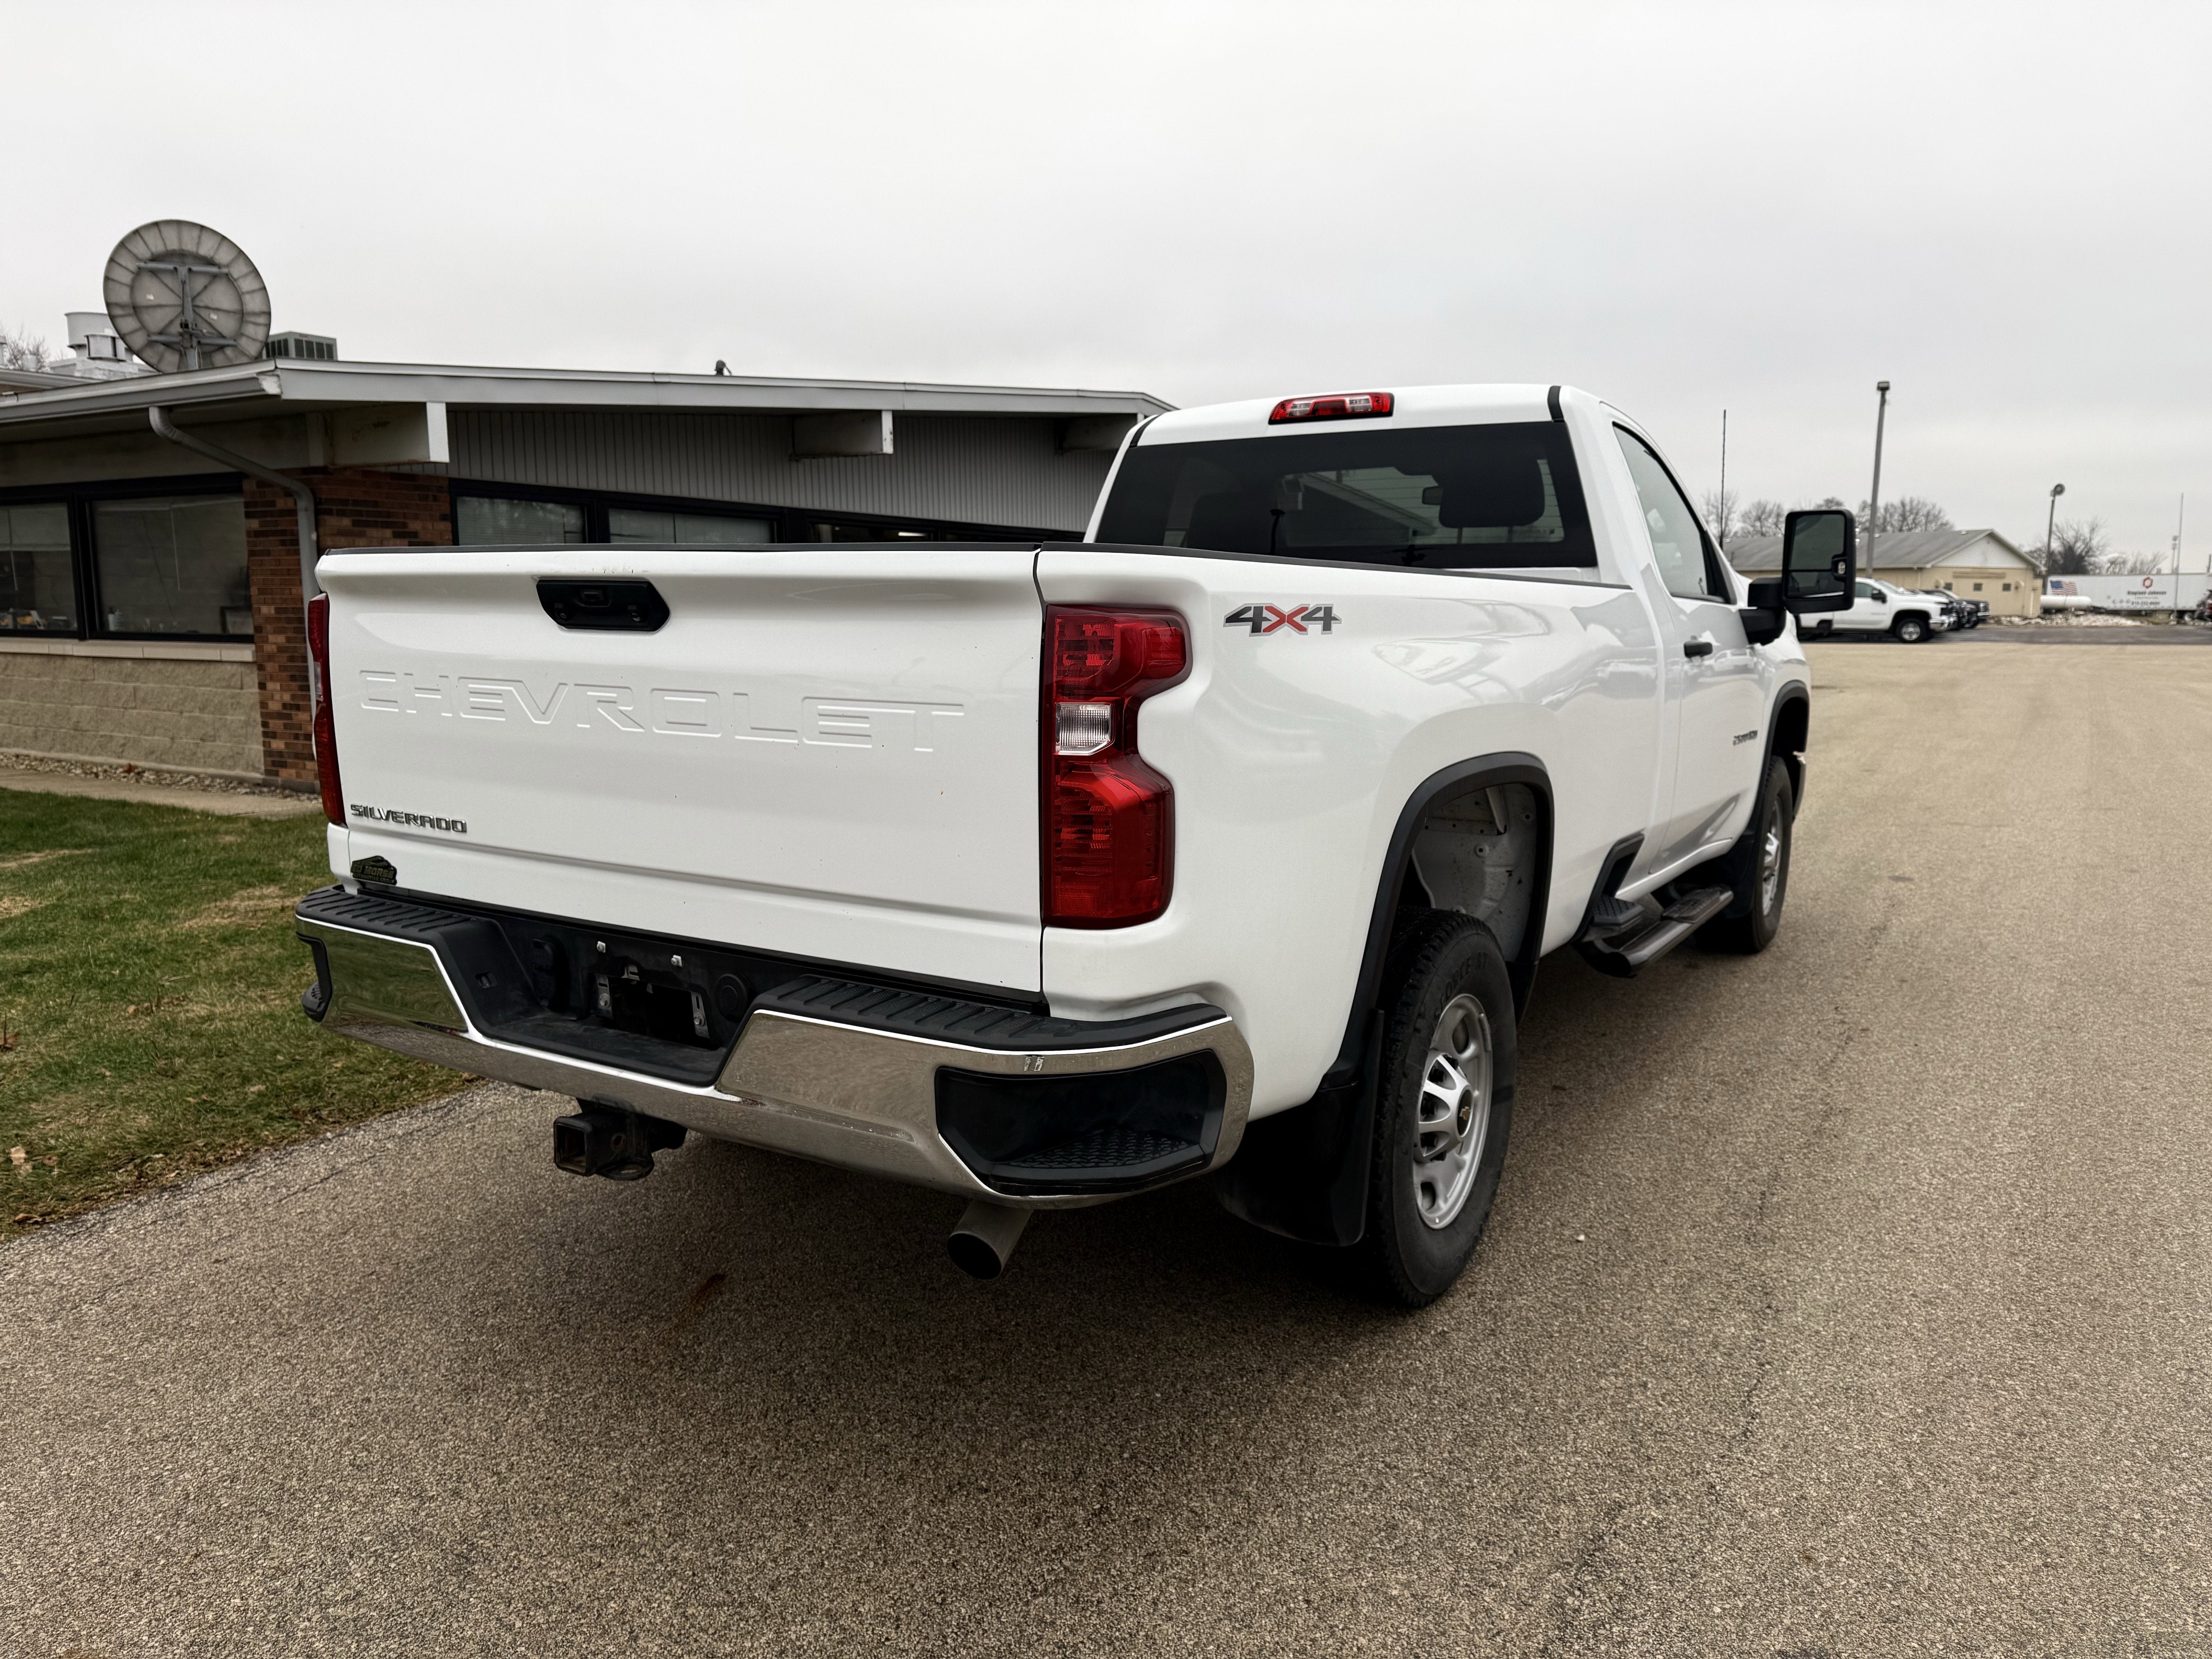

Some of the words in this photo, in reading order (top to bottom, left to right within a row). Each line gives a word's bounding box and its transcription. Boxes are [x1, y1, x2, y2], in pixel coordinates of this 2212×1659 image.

[359, 669, 965, 751] CHEVROLET
[350, 804, 468, 833] SILVERADO
[364, 866, 395, 879] MORSE
